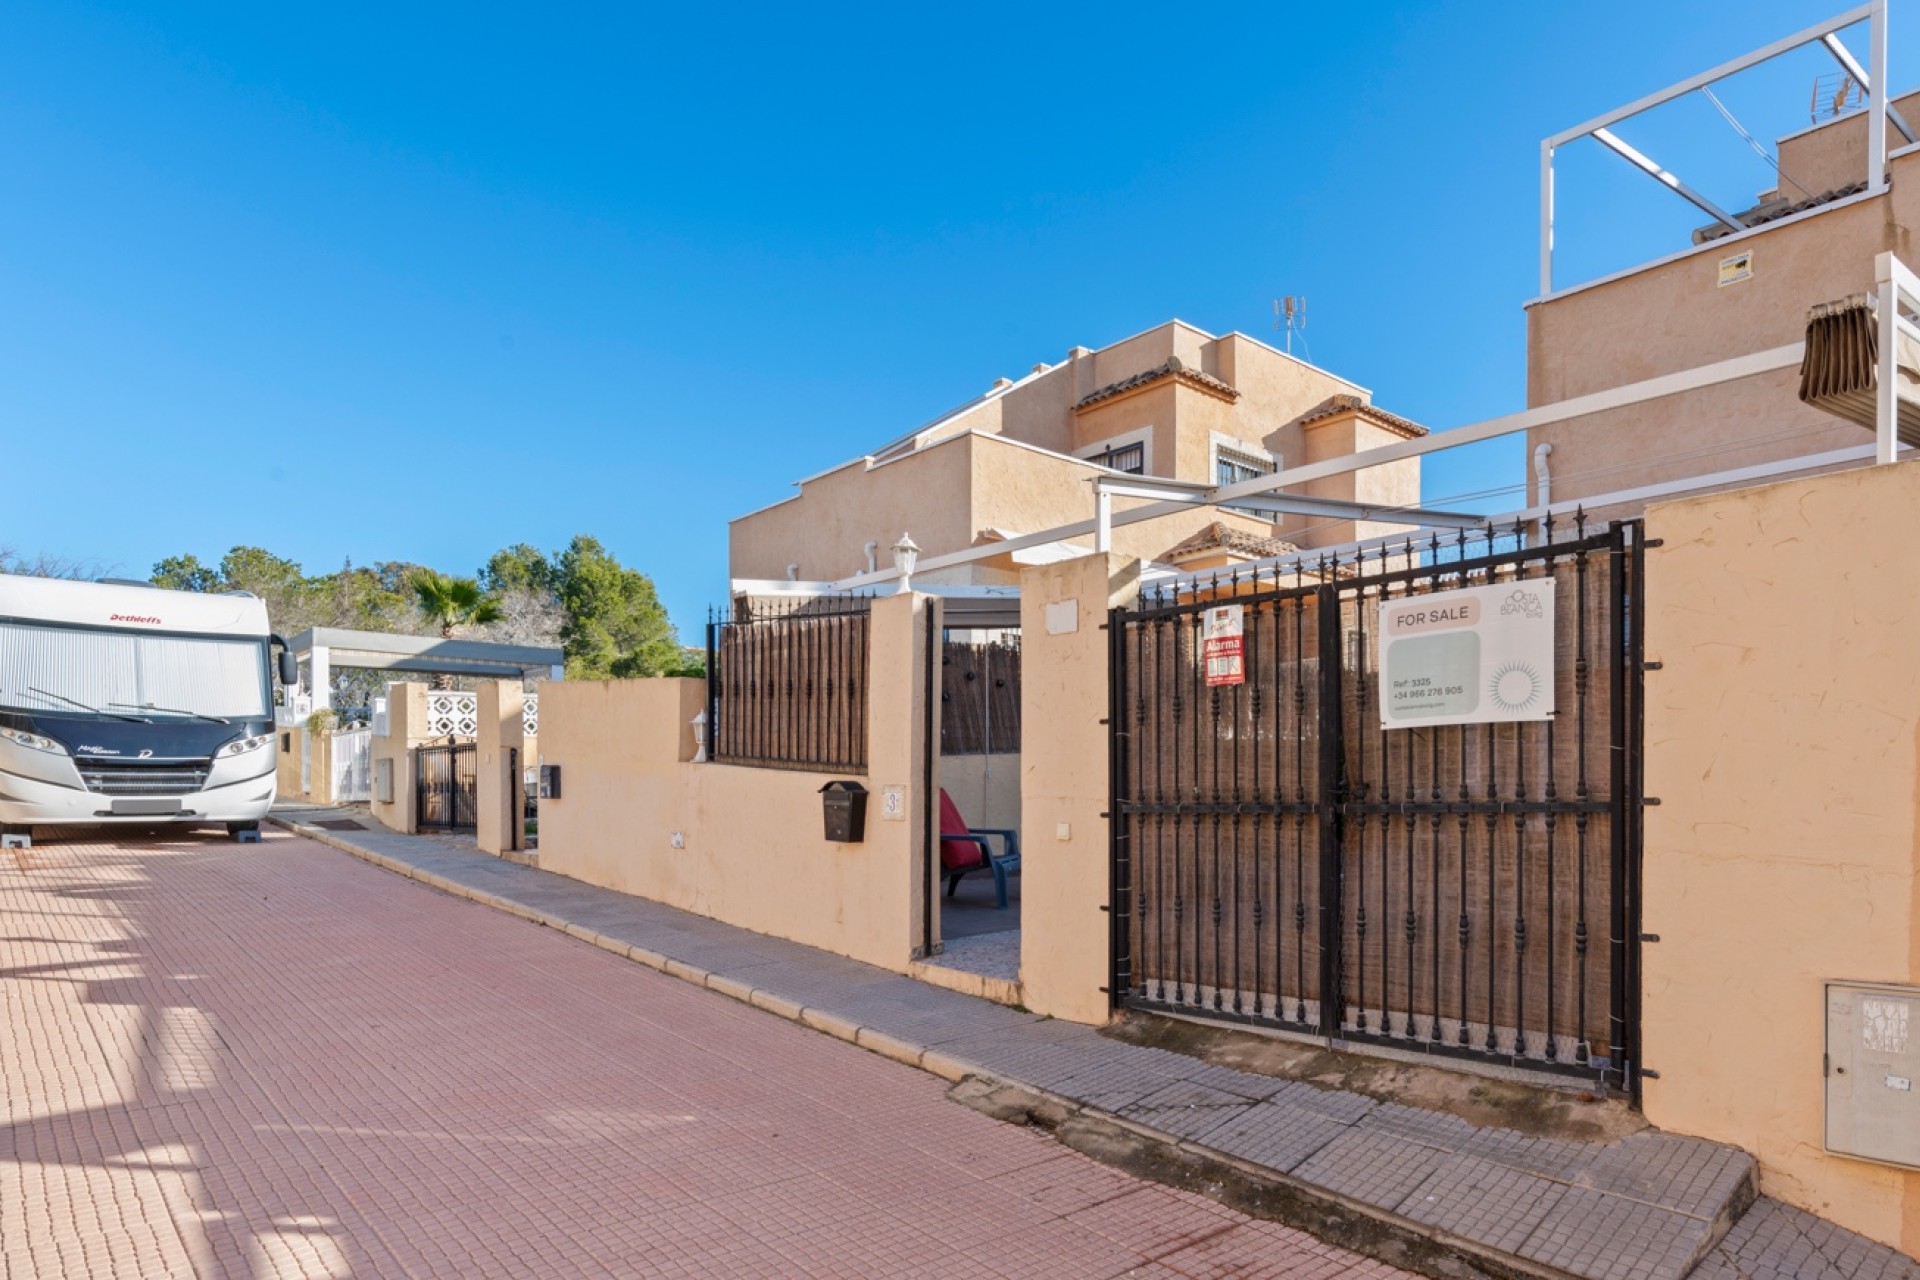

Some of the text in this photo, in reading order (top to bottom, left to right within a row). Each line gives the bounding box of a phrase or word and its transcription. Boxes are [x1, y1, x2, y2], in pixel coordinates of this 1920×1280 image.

[1397, 605, 1469, 628] FOR SALE
[1207, 639, 1240, 651] Alarma
[889, 793, 896, 812] 3
